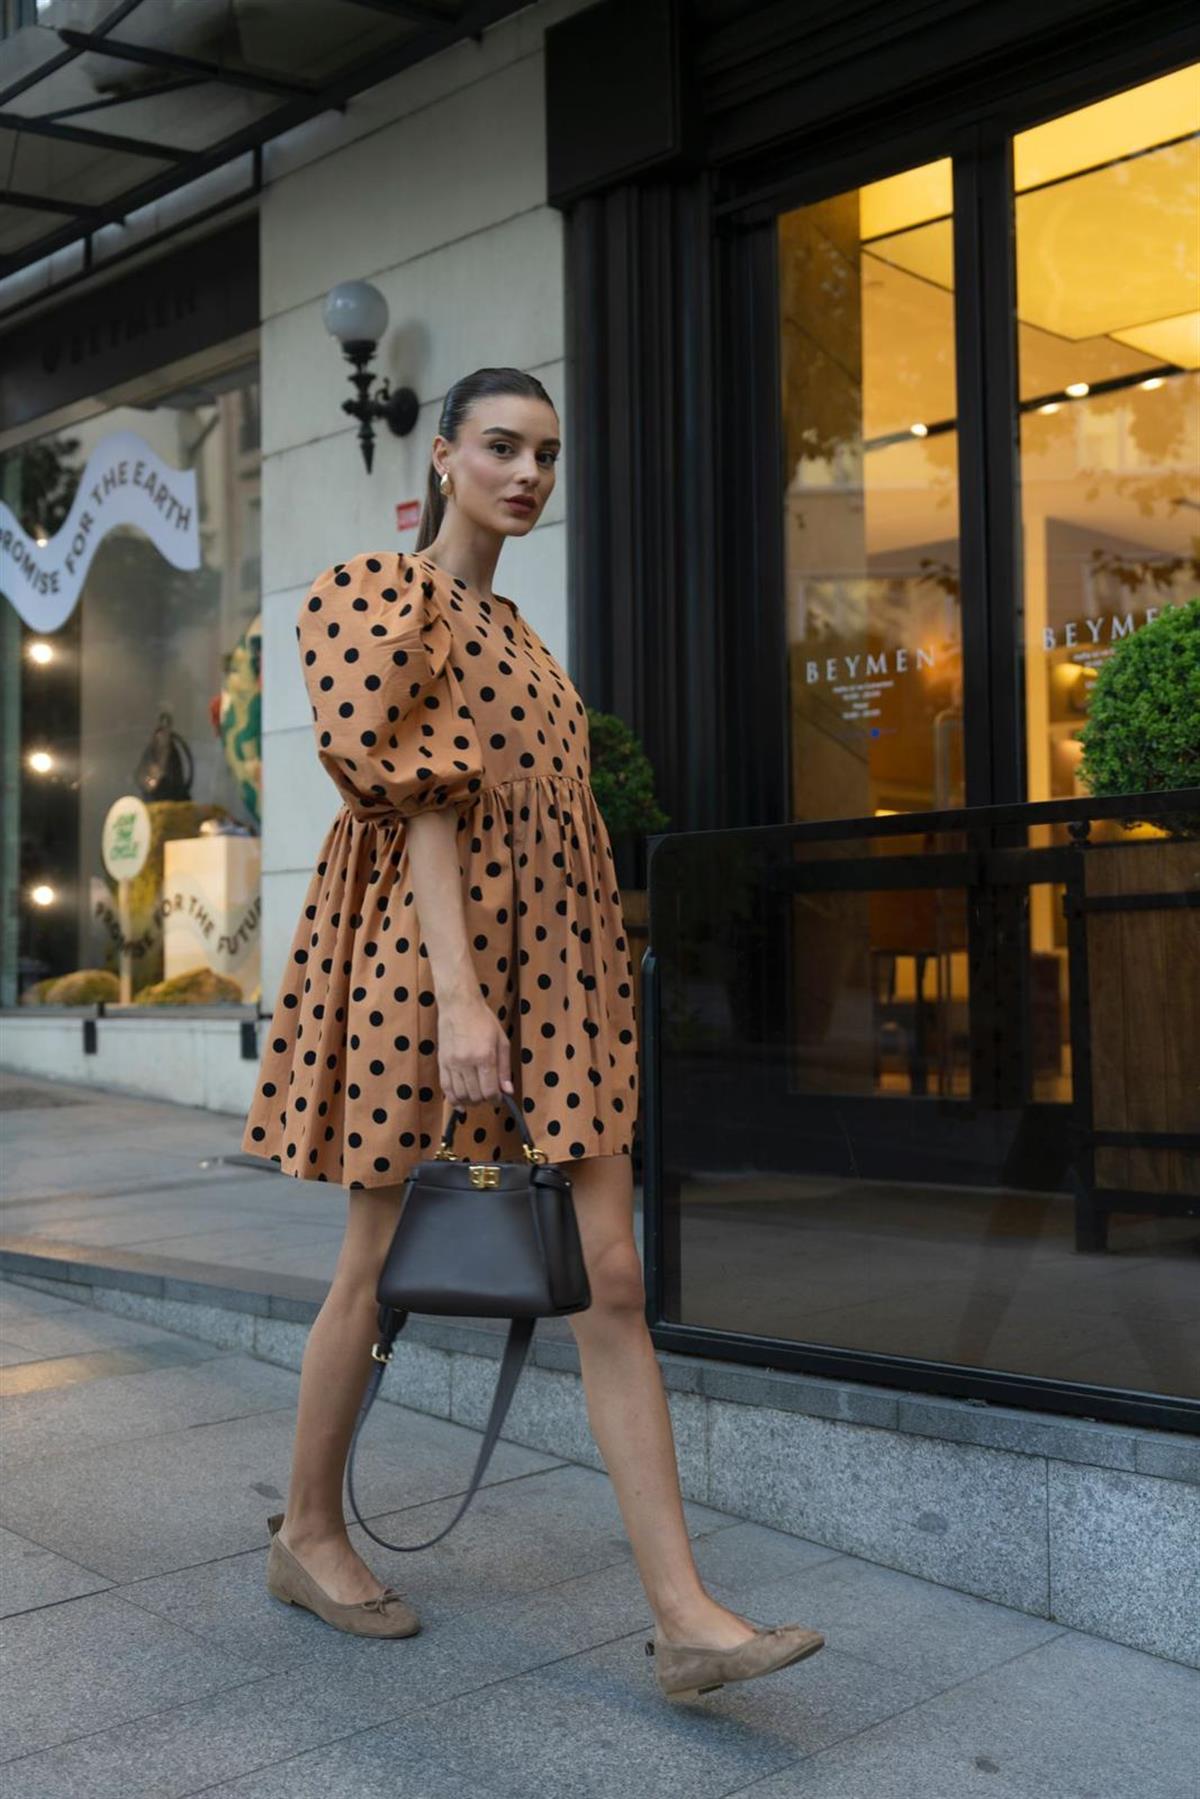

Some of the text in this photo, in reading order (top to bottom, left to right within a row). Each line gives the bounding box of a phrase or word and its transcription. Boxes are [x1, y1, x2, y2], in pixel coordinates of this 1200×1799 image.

[65, 512, 94, 575] FOR
[90, 461, 128, 506] THE
[132, 461, 192, 532] EARTH
[806, 648, 935, 684] BEYMEN
[189, 898, 215, 939] THE
